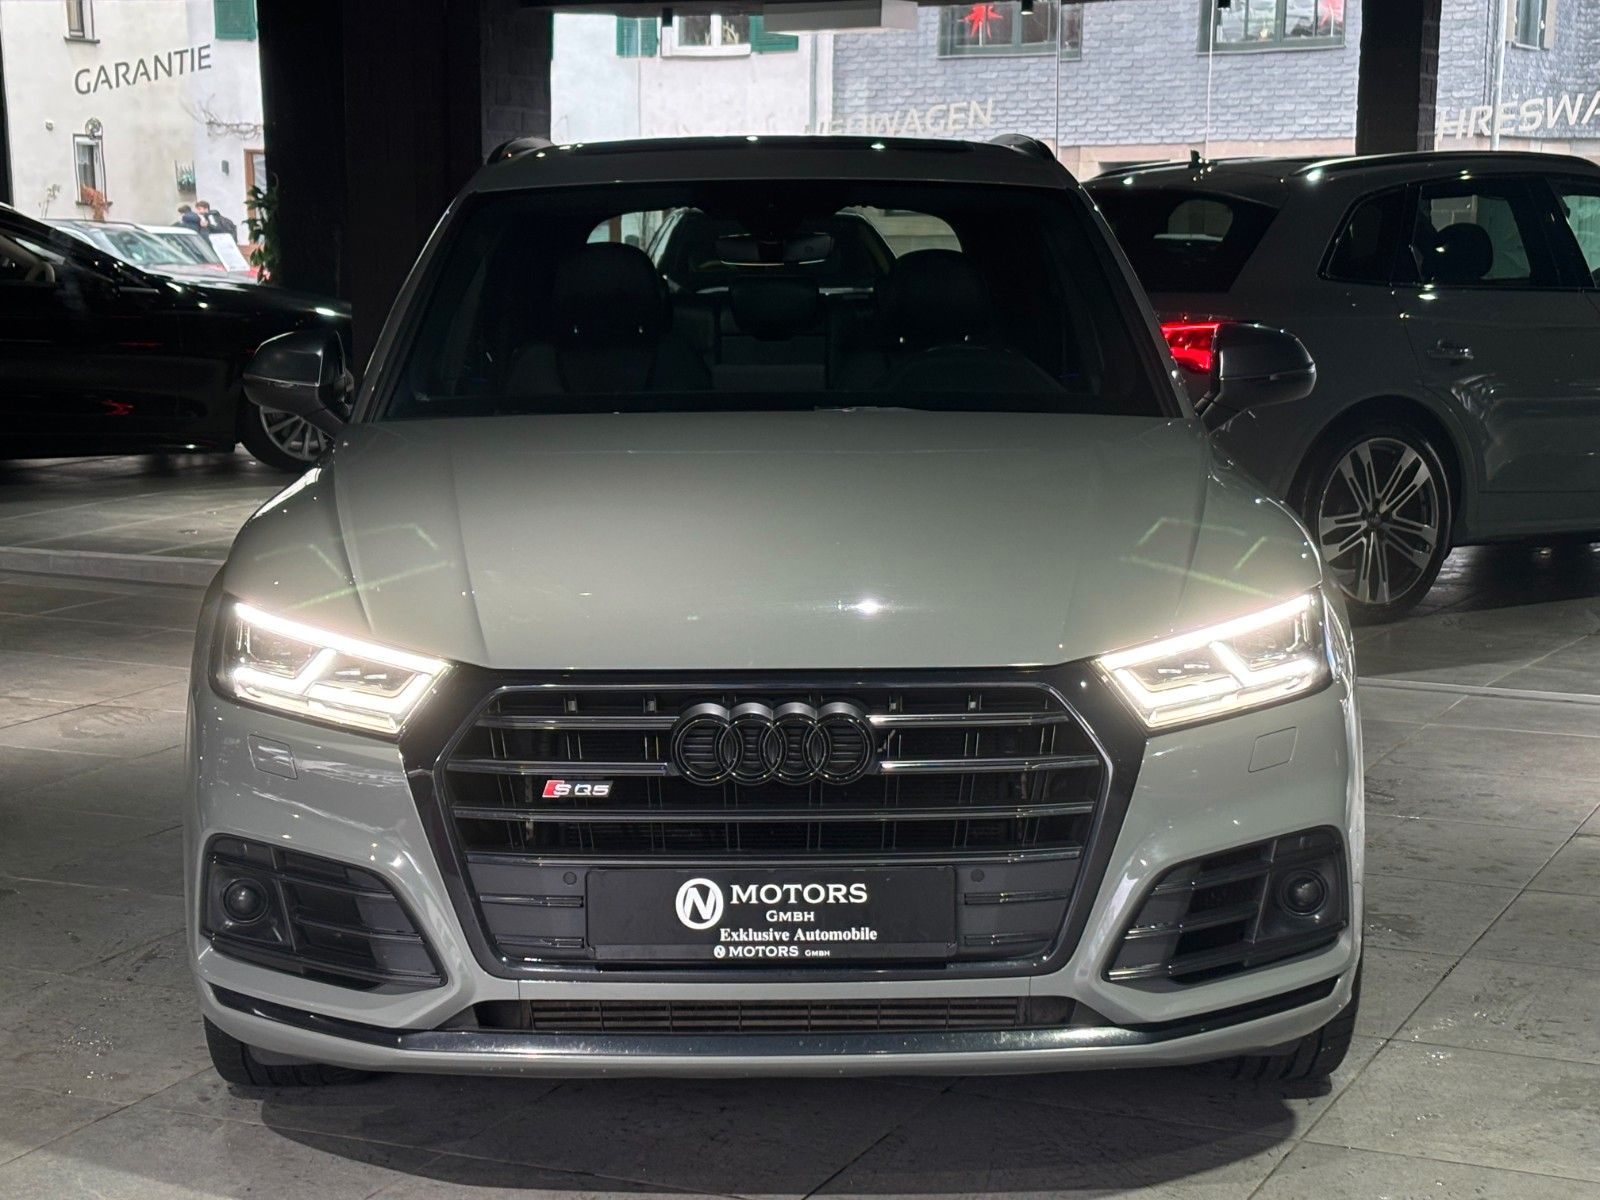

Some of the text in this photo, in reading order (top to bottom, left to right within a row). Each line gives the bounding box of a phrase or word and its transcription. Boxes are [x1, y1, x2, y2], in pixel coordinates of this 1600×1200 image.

[74, 44, 212, 95] GARANTIE
[553, 783, 609, 796] SQ5
[730, 883, 868, 904] MOTORS
[719, 927, 878, 942] Exklusive Automobile
[729, 945, 799, 957] MOTORS
